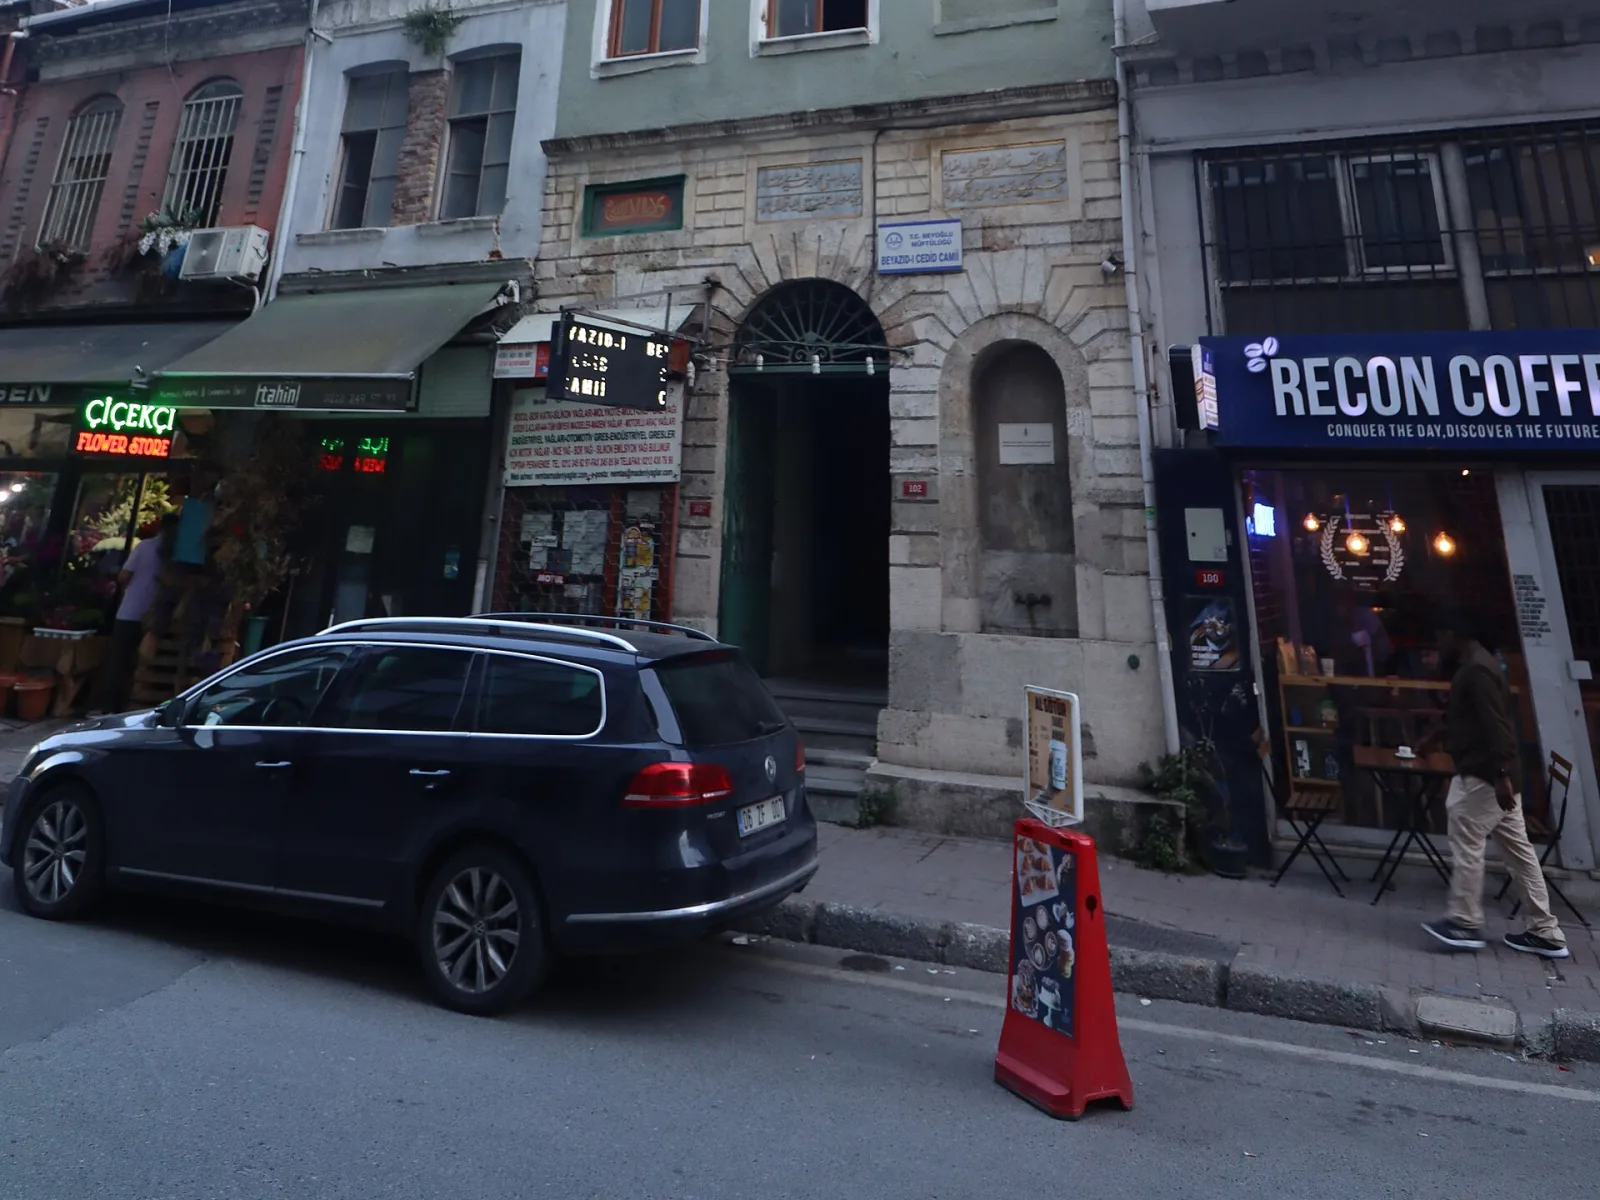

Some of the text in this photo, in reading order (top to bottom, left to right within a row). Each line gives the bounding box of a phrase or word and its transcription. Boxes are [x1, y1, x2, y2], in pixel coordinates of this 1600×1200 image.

[922, 230, 953, 239] BEYOĞLU
[911, 238, 952, 247] MÜFTÜLÜĞÜ
[881, 249, 960, 265] BEYAZID-I CEDİD CAMİİ
[1270, 355, 1440, 416] RECON
[1327, 423, 1387, 437] CONQUER
[1388, 423, 1414, 437] THE
[1515, 424, 1543, 438] THE
[1546, 424, 1600, 438] FUTURE
[76, 432, 170, 457] FLOWER STORE
[908, 484, 923, 493] 102
[1202, 573, 1219, 583] 100
